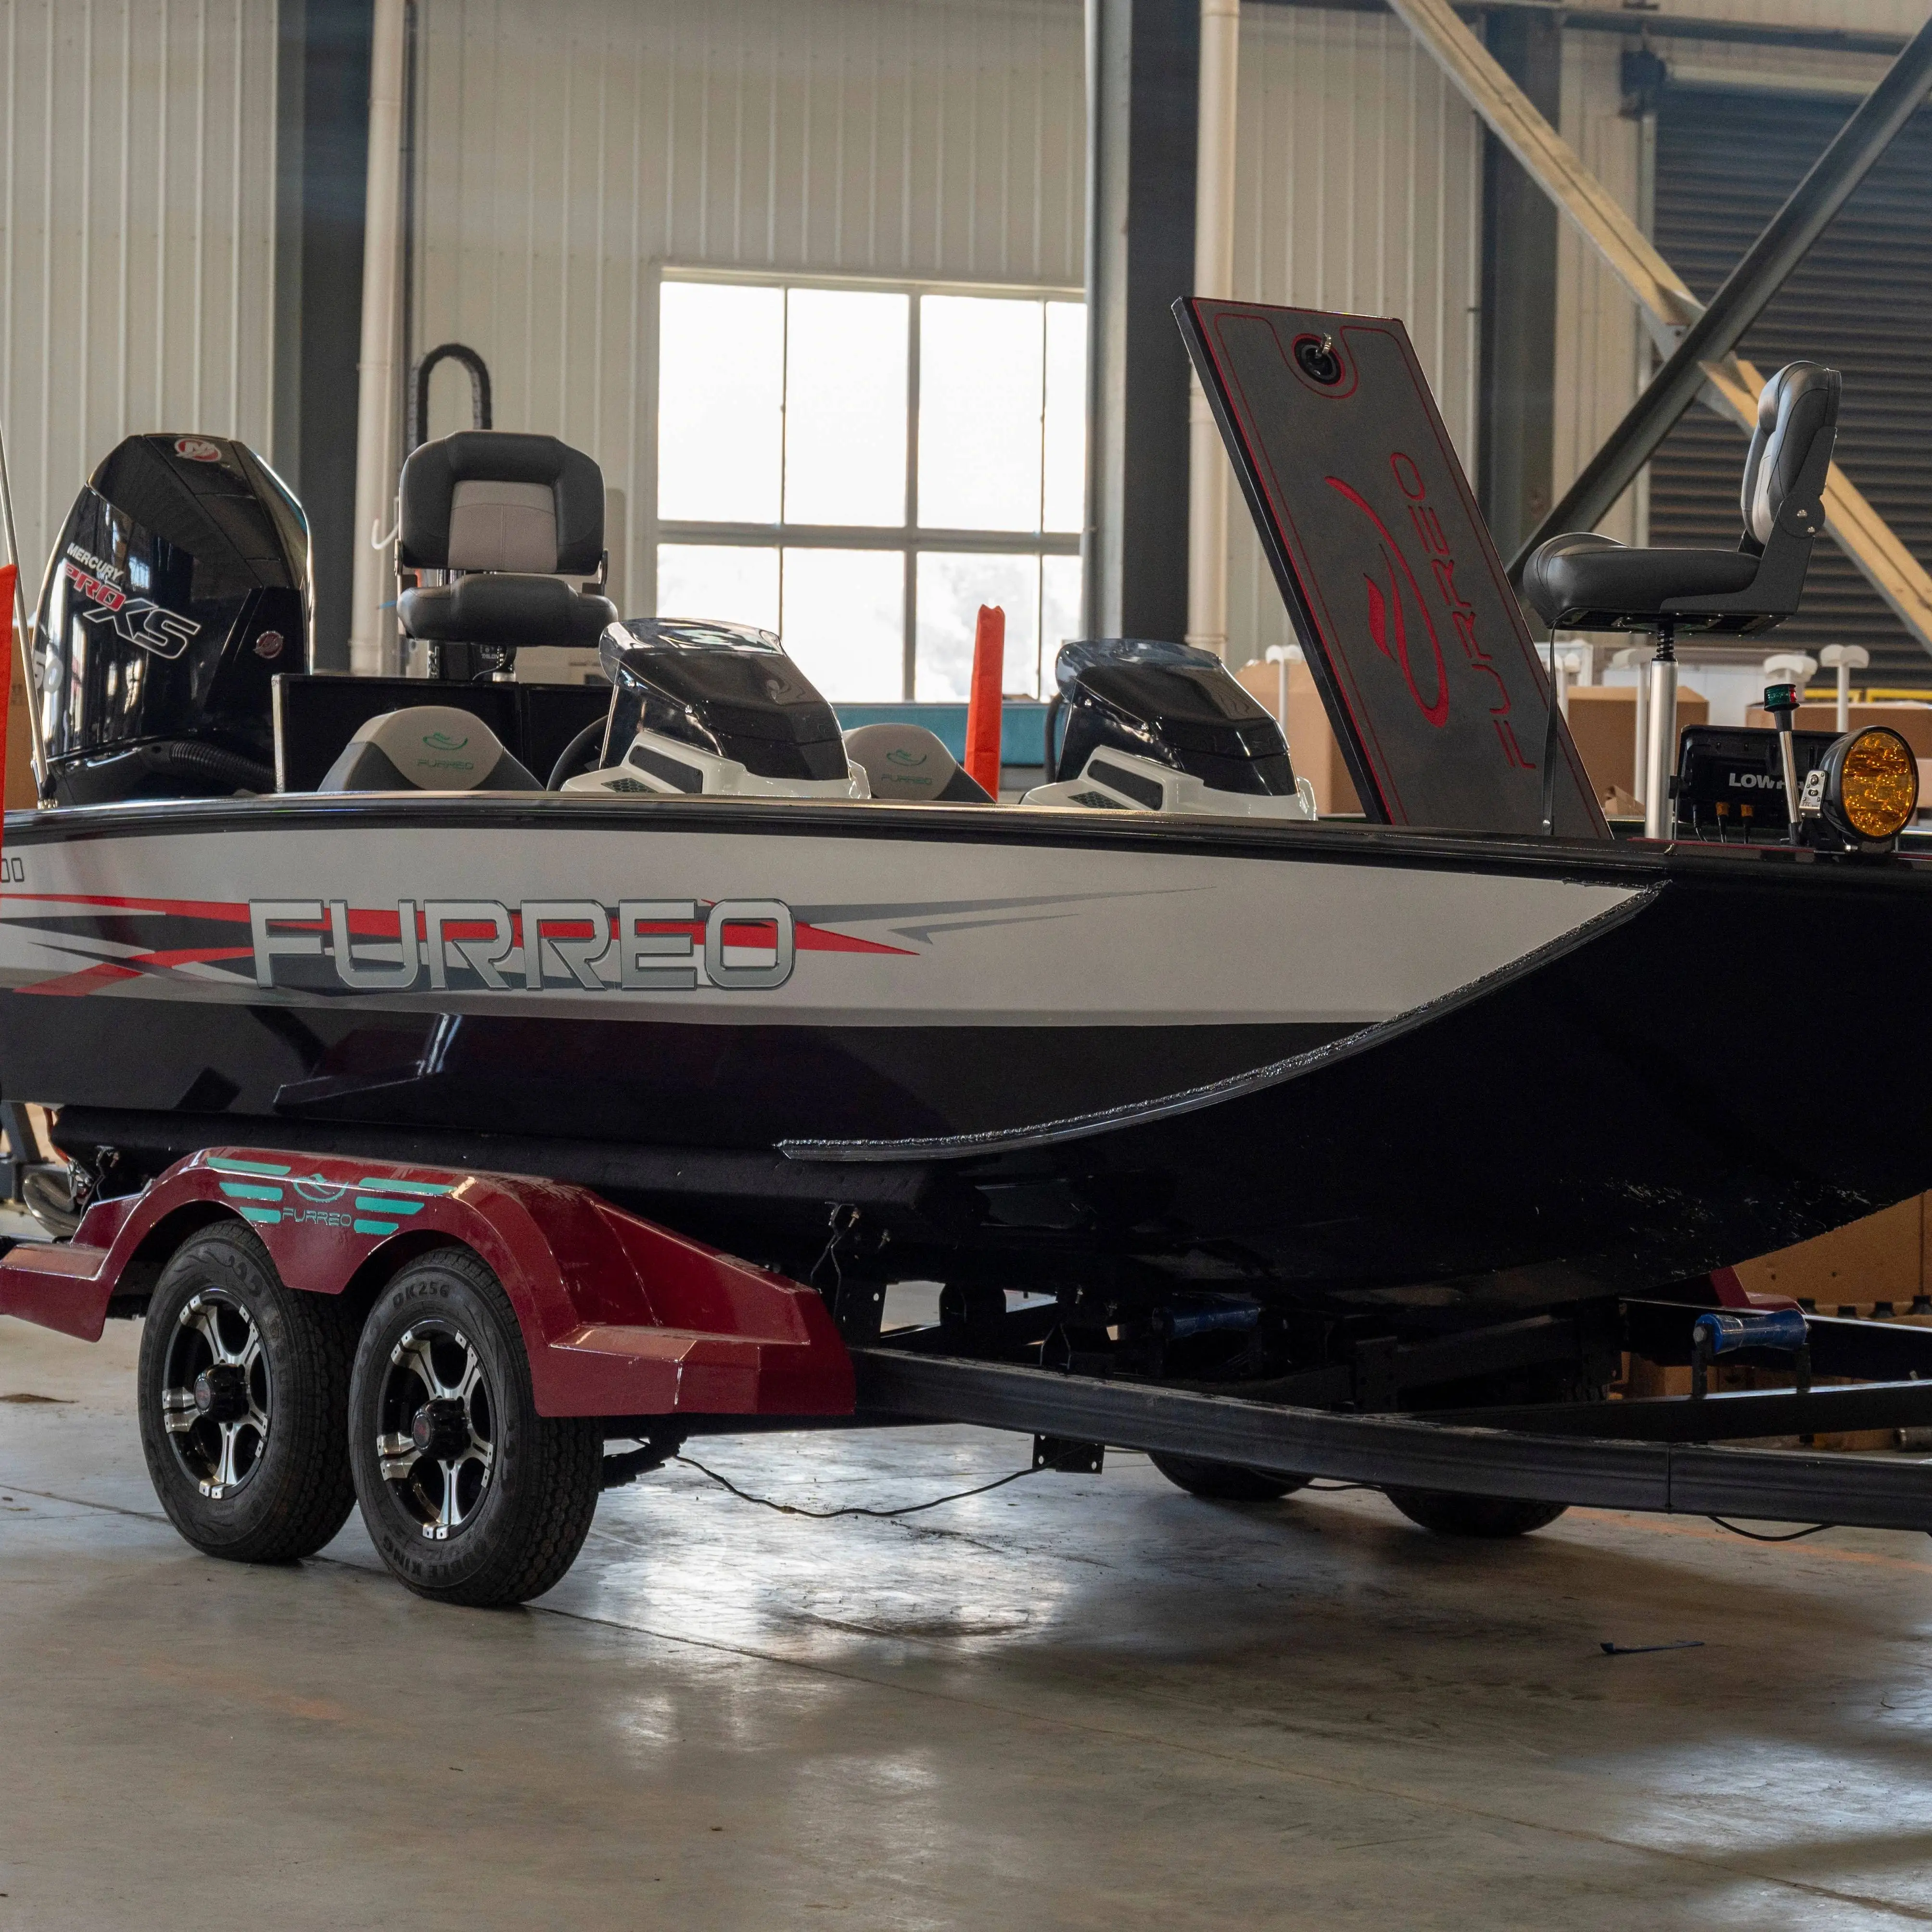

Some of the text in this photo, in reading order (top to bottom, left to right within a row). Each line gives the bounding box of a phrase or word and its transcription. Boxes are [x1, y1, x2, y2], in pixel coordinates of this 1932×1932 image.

[66, 542, 125, 581] MERCURY
[65, 561, 201, 659] PRO XS
[1390, 452, 1536, 770] FURREO
[249, 898, 796, 991] FURREO
[283, 1207, 352, 1227] FURREO
